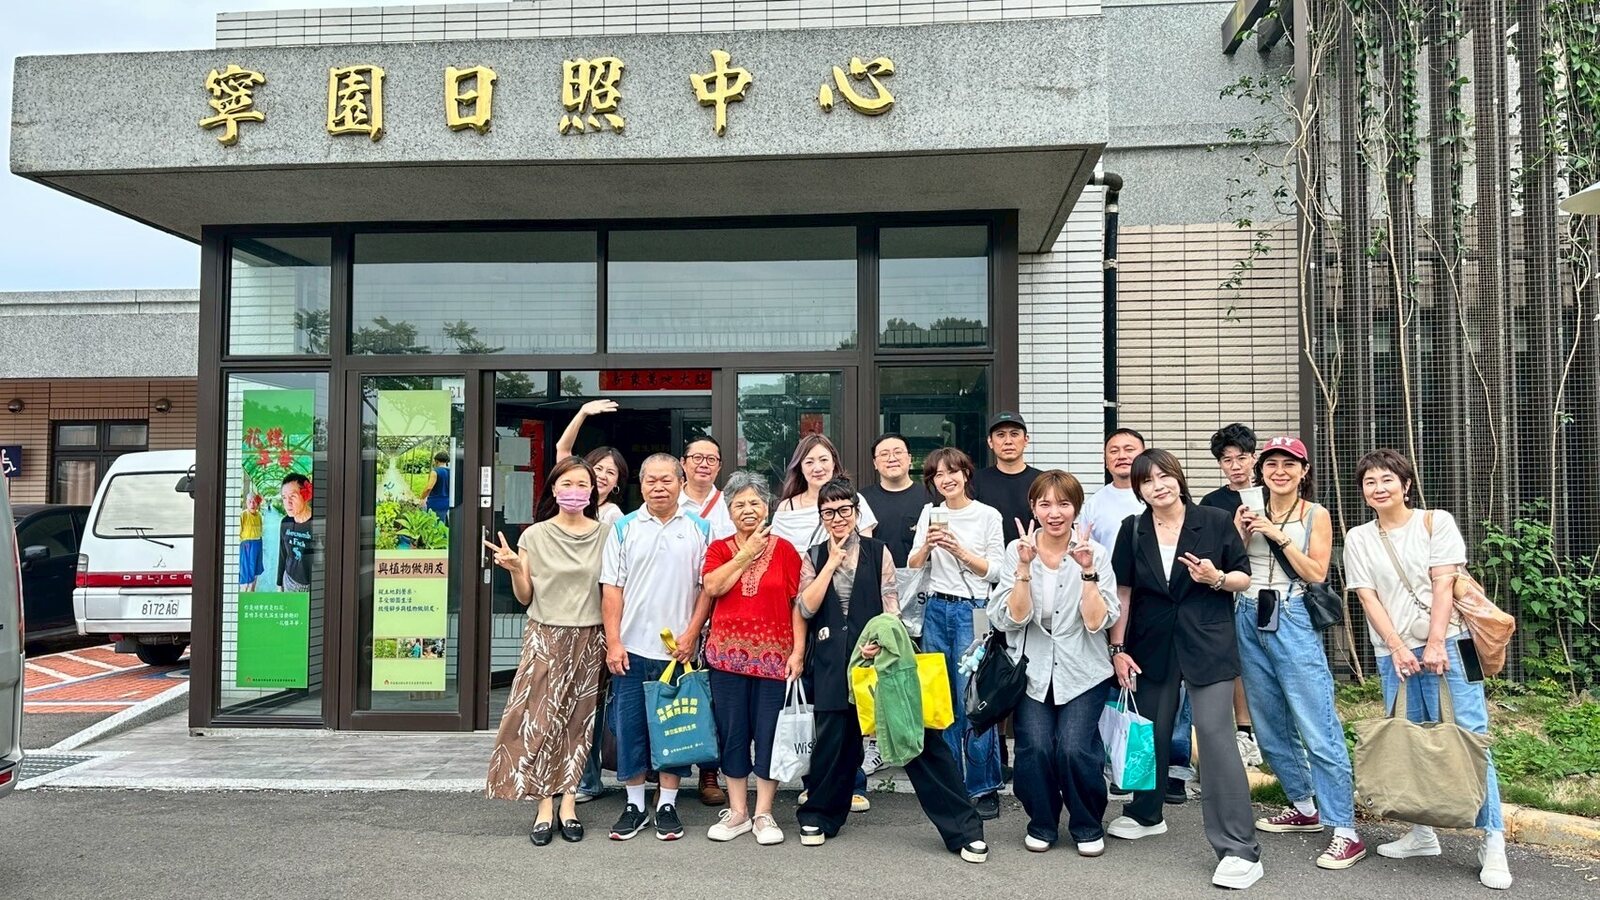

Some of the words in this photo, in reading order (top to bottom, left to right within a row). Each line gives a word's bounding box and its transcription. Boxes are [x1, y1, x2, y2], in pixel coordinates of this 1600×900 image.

[378, 562, 445, 576] 與植物做朋友
